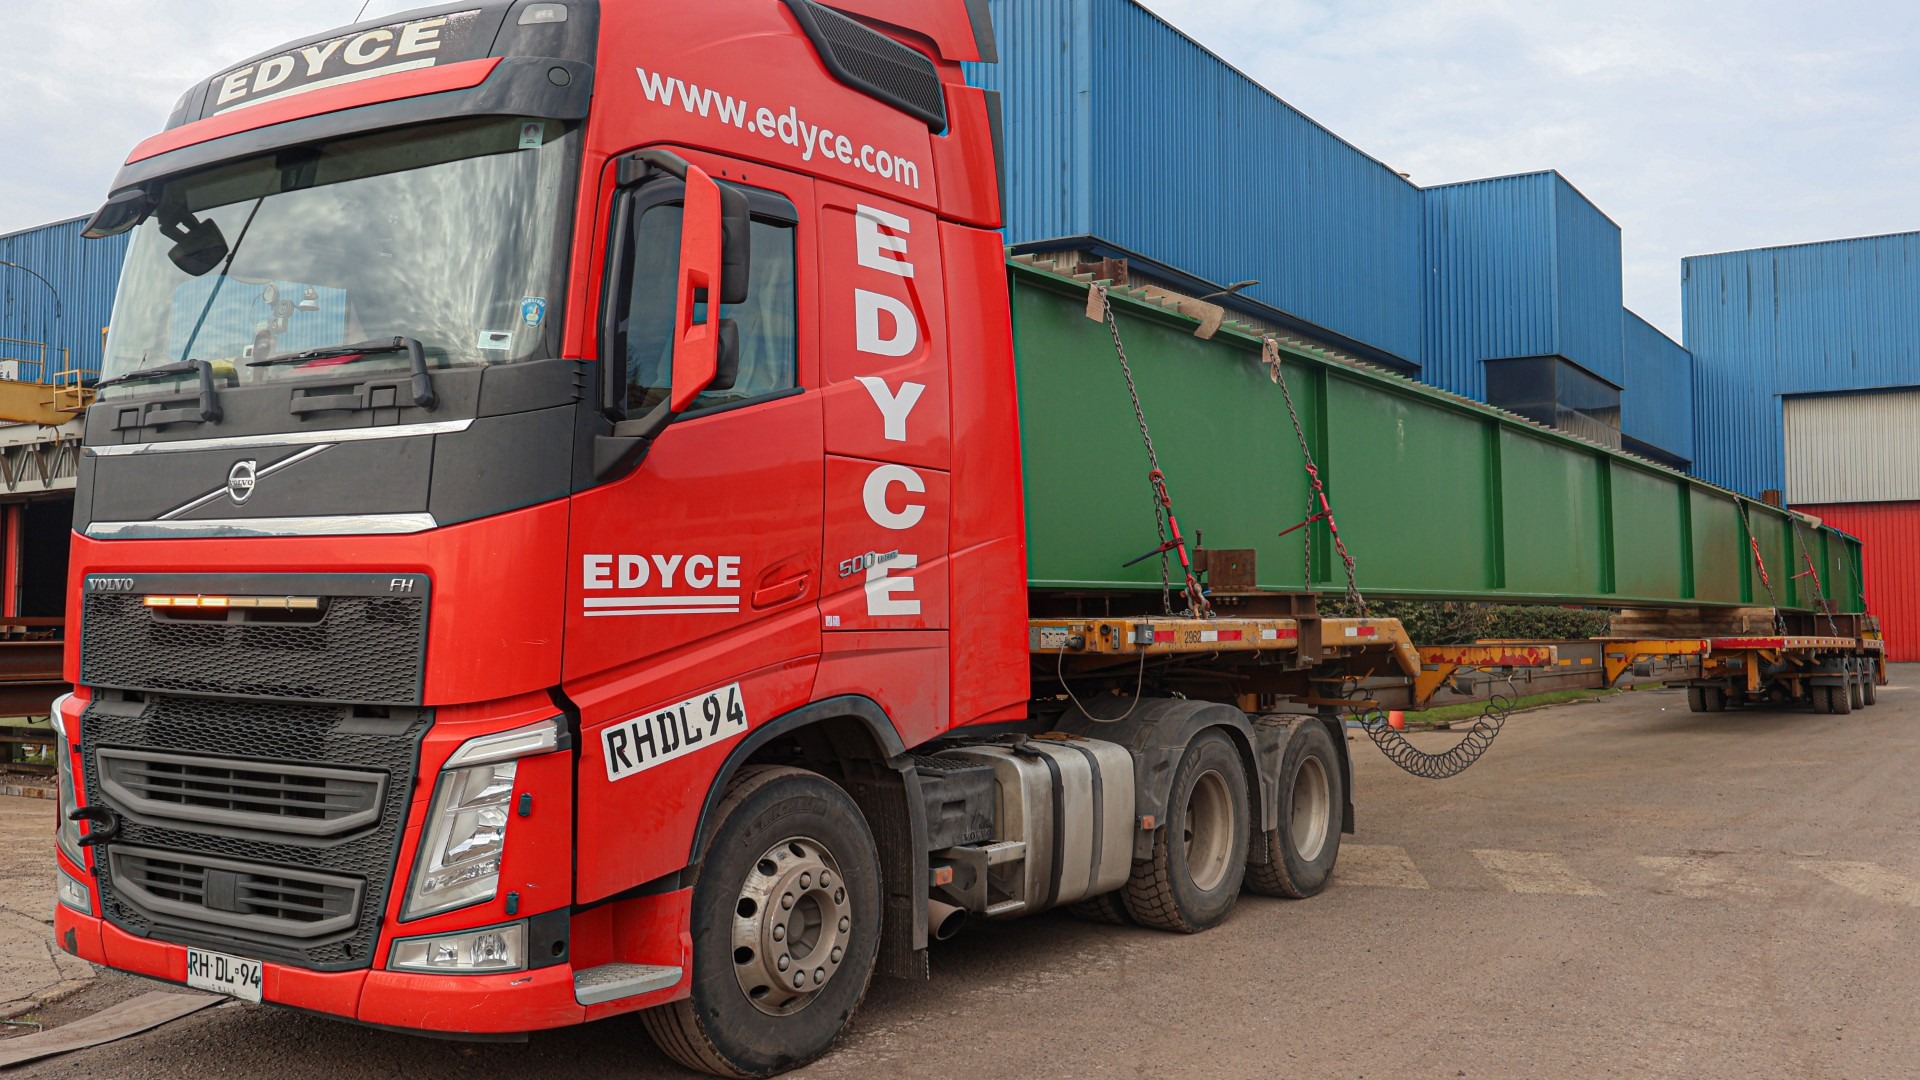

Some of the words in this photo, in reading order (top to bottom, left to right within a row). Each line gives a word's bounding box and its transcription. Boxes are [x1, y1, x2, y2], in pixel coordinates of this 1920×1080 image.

[217, 18, 447, 106] EDYCE
[636, 67, 919, 189] www.edyce.com
[854, 203, 926, 616] EDYCE
[230, 479, 254, 487] VOLVO
[583, 554, 741, 590] EDYCE
[839, 550, 876, 578] 500
[88, 578, 134, 591] VOLVO
[390, 578, 414, 592] FH
